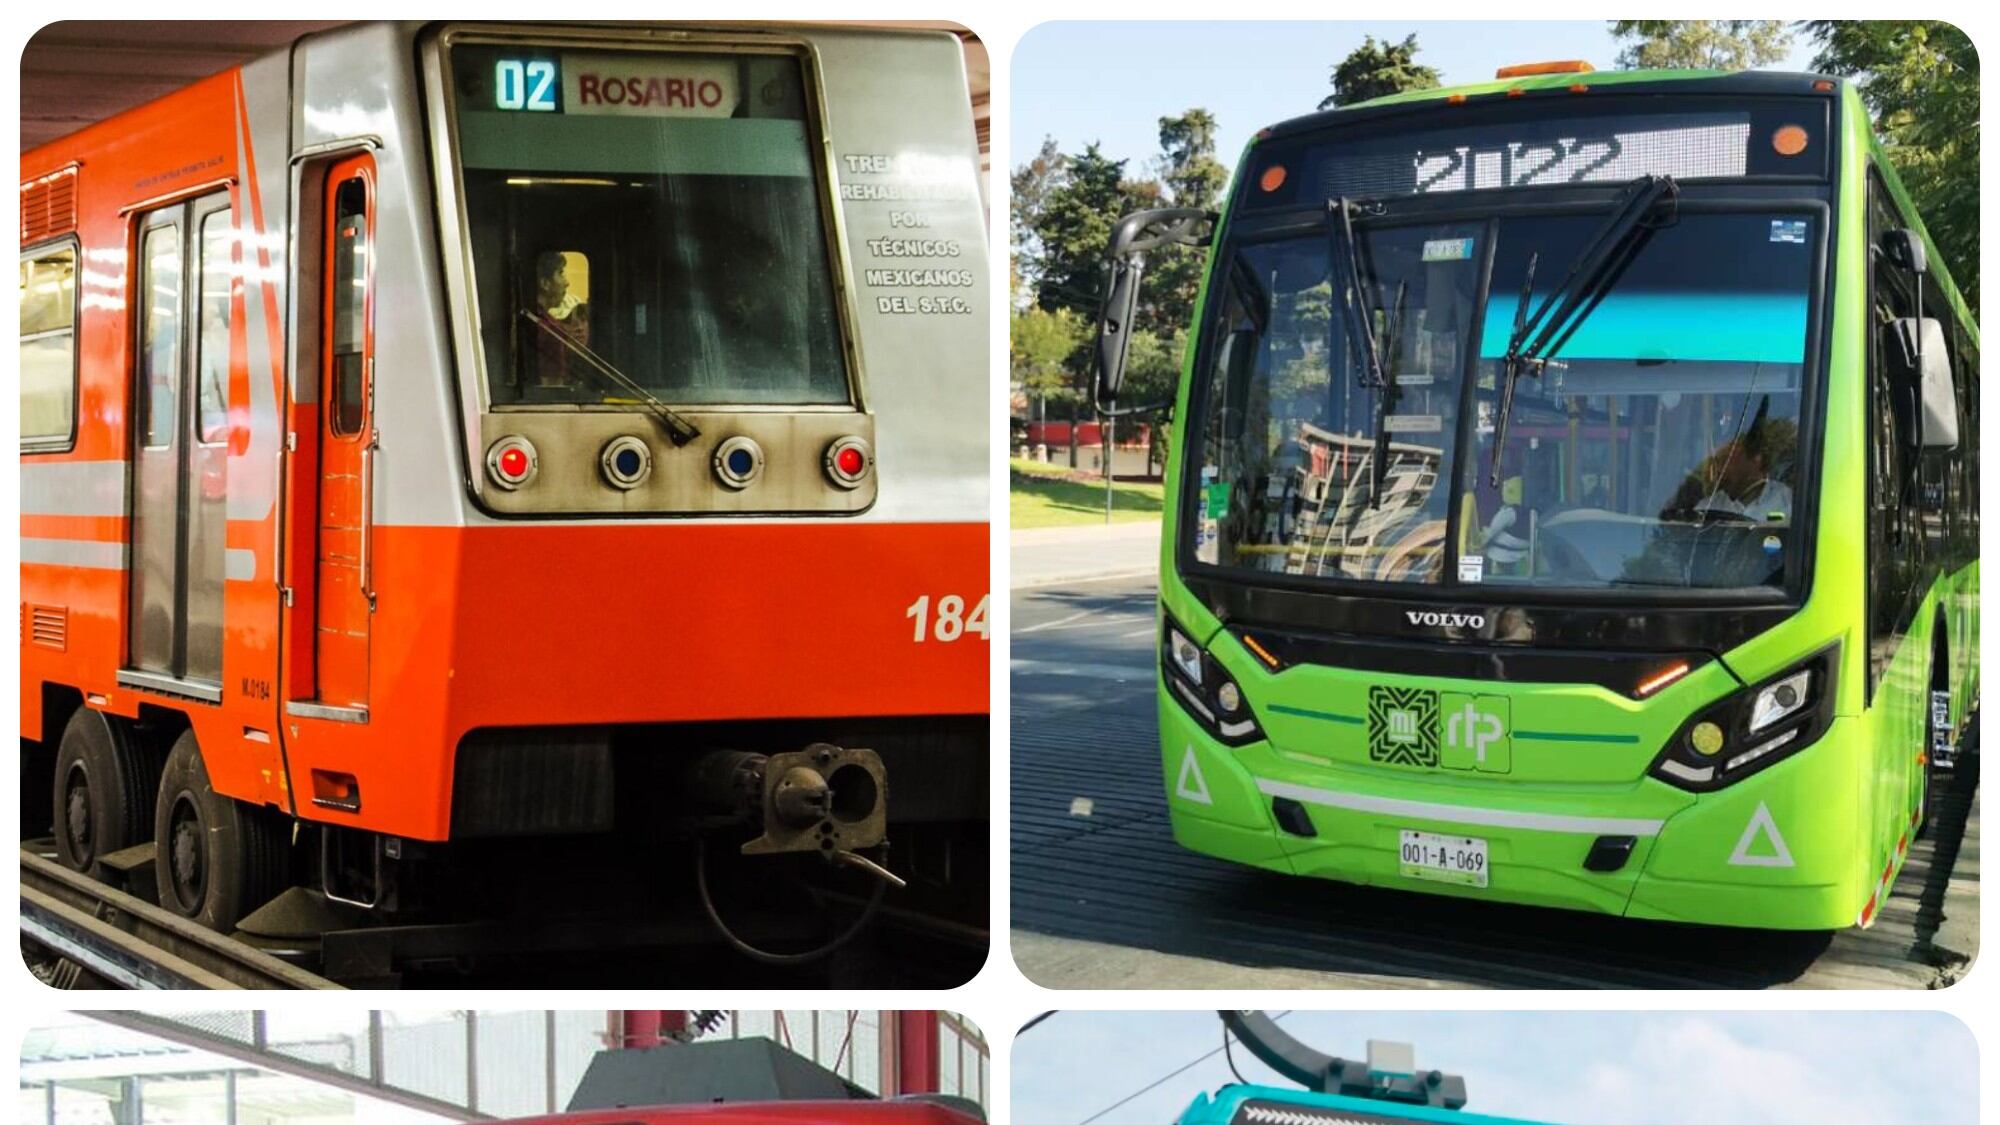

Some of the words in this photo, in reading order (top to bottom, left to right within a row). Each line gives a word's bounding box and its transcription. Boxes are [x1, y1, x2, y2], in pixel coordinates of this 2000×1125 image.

[496, 60, 555, 111] 02
[579, 75, 722, 108] ROSARIO
[867, 236, 960, 257] TÉCNICOS
[865, 268, 973, 287] MEXICANOS
[877, 297, 916, 314] DEL
[919, 296, 972, 315] S.T.C.
[906, 593, 990, 642] 184
[1405, 611, 1485, 629] VOLVO
[1403, 843, 1484, 871] 001-A-069
